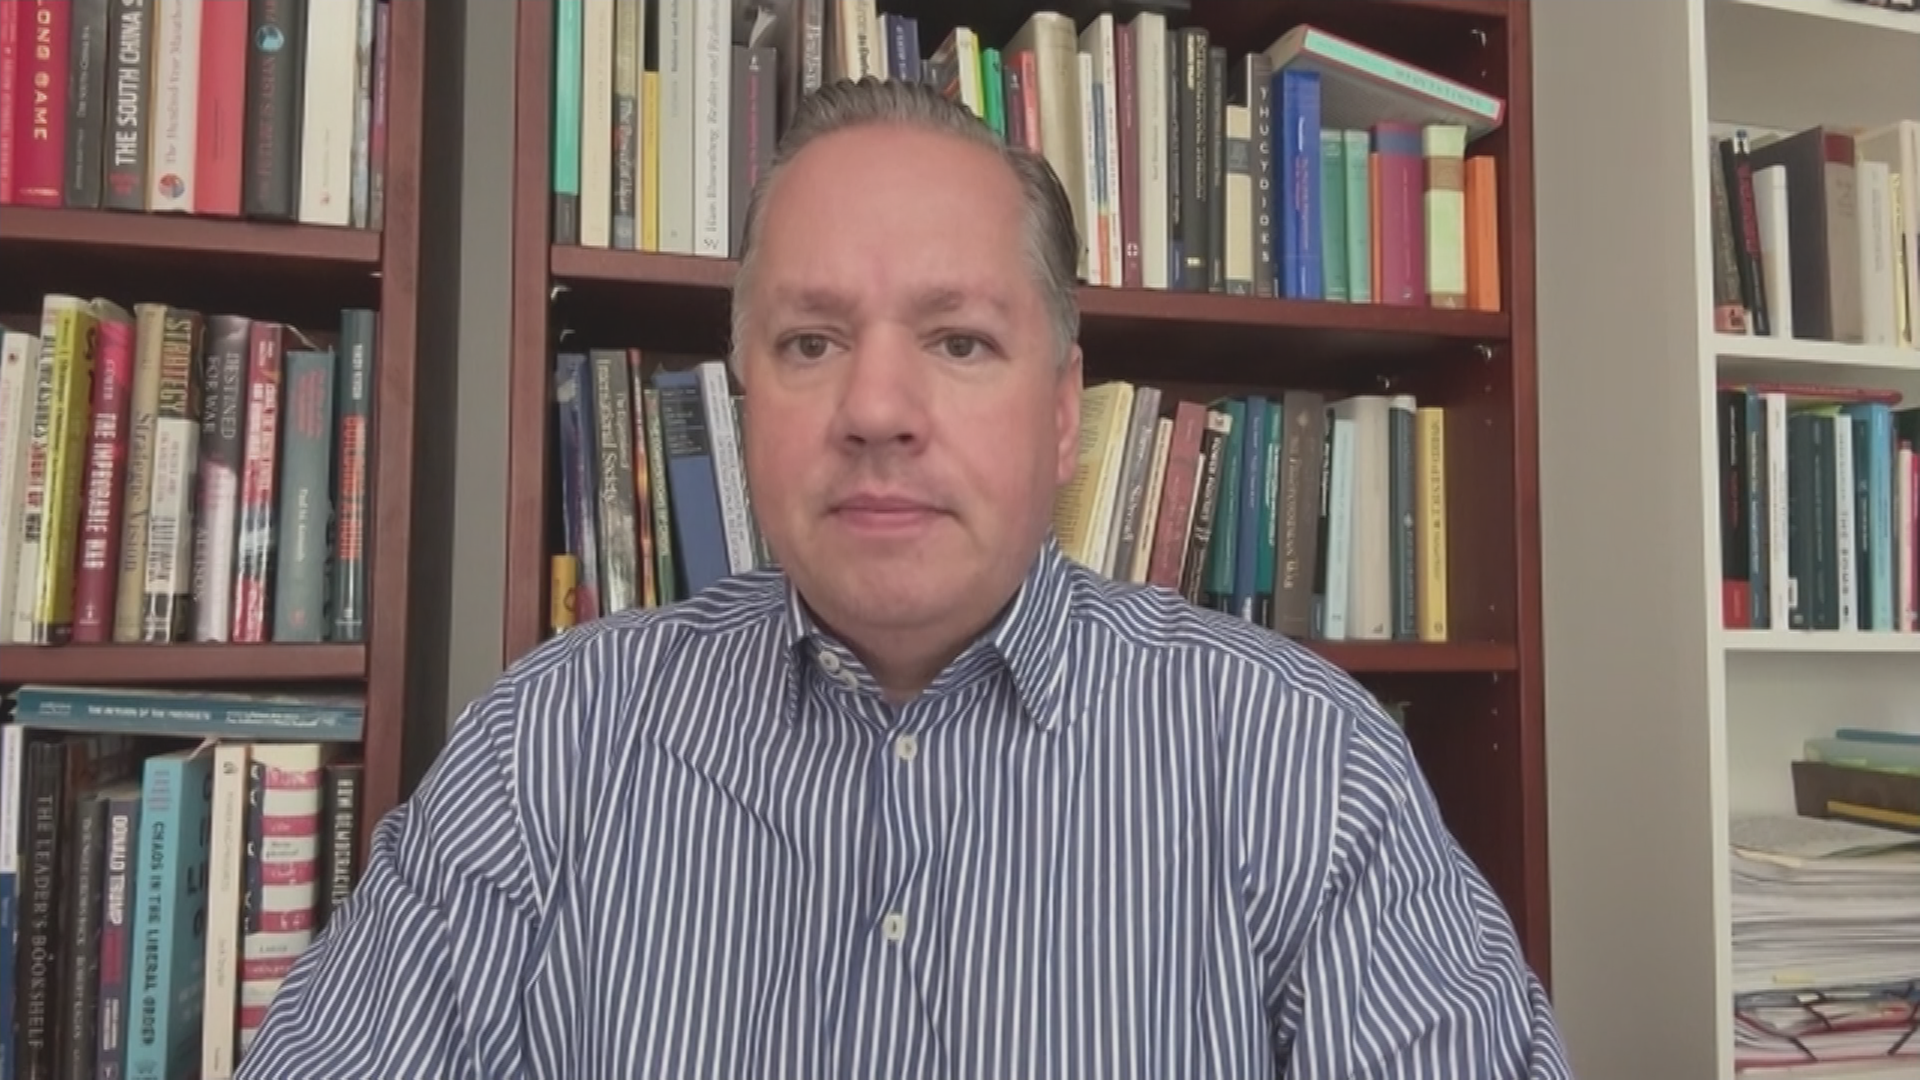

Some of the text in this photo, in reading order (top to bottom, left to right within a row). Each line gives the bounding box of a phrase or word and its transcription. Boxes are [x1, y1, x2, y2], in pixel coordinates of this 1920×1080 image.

[118, 11, 143, 64] CHINA
[34, 71, 50, 141] GAME
[115, 131, 138, 166] THE
[116, 68, 141, 126] SOUTH
[1259, 86, 1270, 262] THUCYDIDES
[160, 317, 191, 412] STRATEGY
[202, 356, 220, 433] FOR WAR
[221, 352, 240, 439] DESTINED
[597, 358, 618, 502] International Society
[83, 412, 117, 569] THE IMPROBABLE WAR
[124, 410, 152, 572] Strategic Vision
[27, 793, 53, 1050] THE LEADER'S BOOKSHELF
[107, 815, 128, 926] DONALD TRUMP
[141, 821, 165, 1046] CHAOS IN THE LIBERAL ORDER
